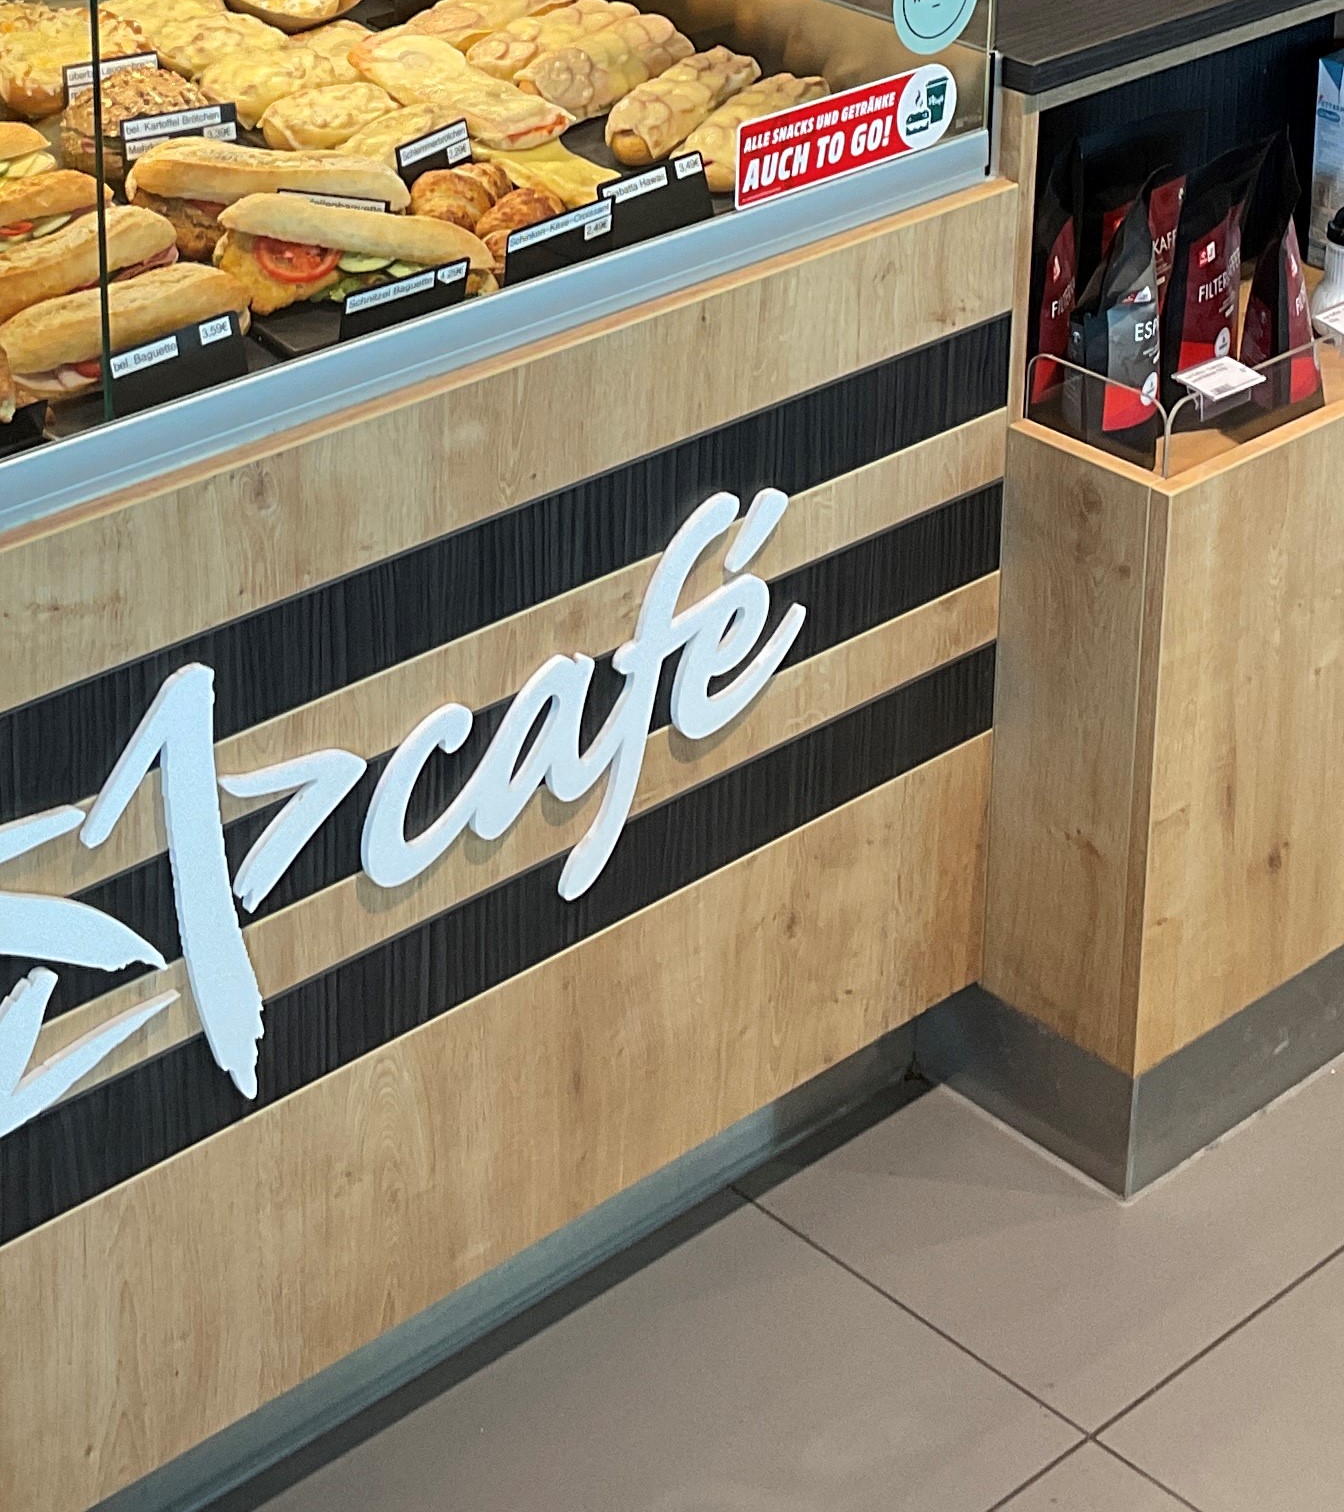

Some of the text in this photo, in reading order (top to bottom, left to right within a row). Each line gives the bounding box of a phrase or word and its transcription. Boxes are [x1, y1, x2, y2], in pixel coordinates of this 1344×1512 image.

[741, 114, 894, 195] AUCH TO GO!
[743, 90, 897, 154] ALLE SNACKS UND GETRÄNKE
